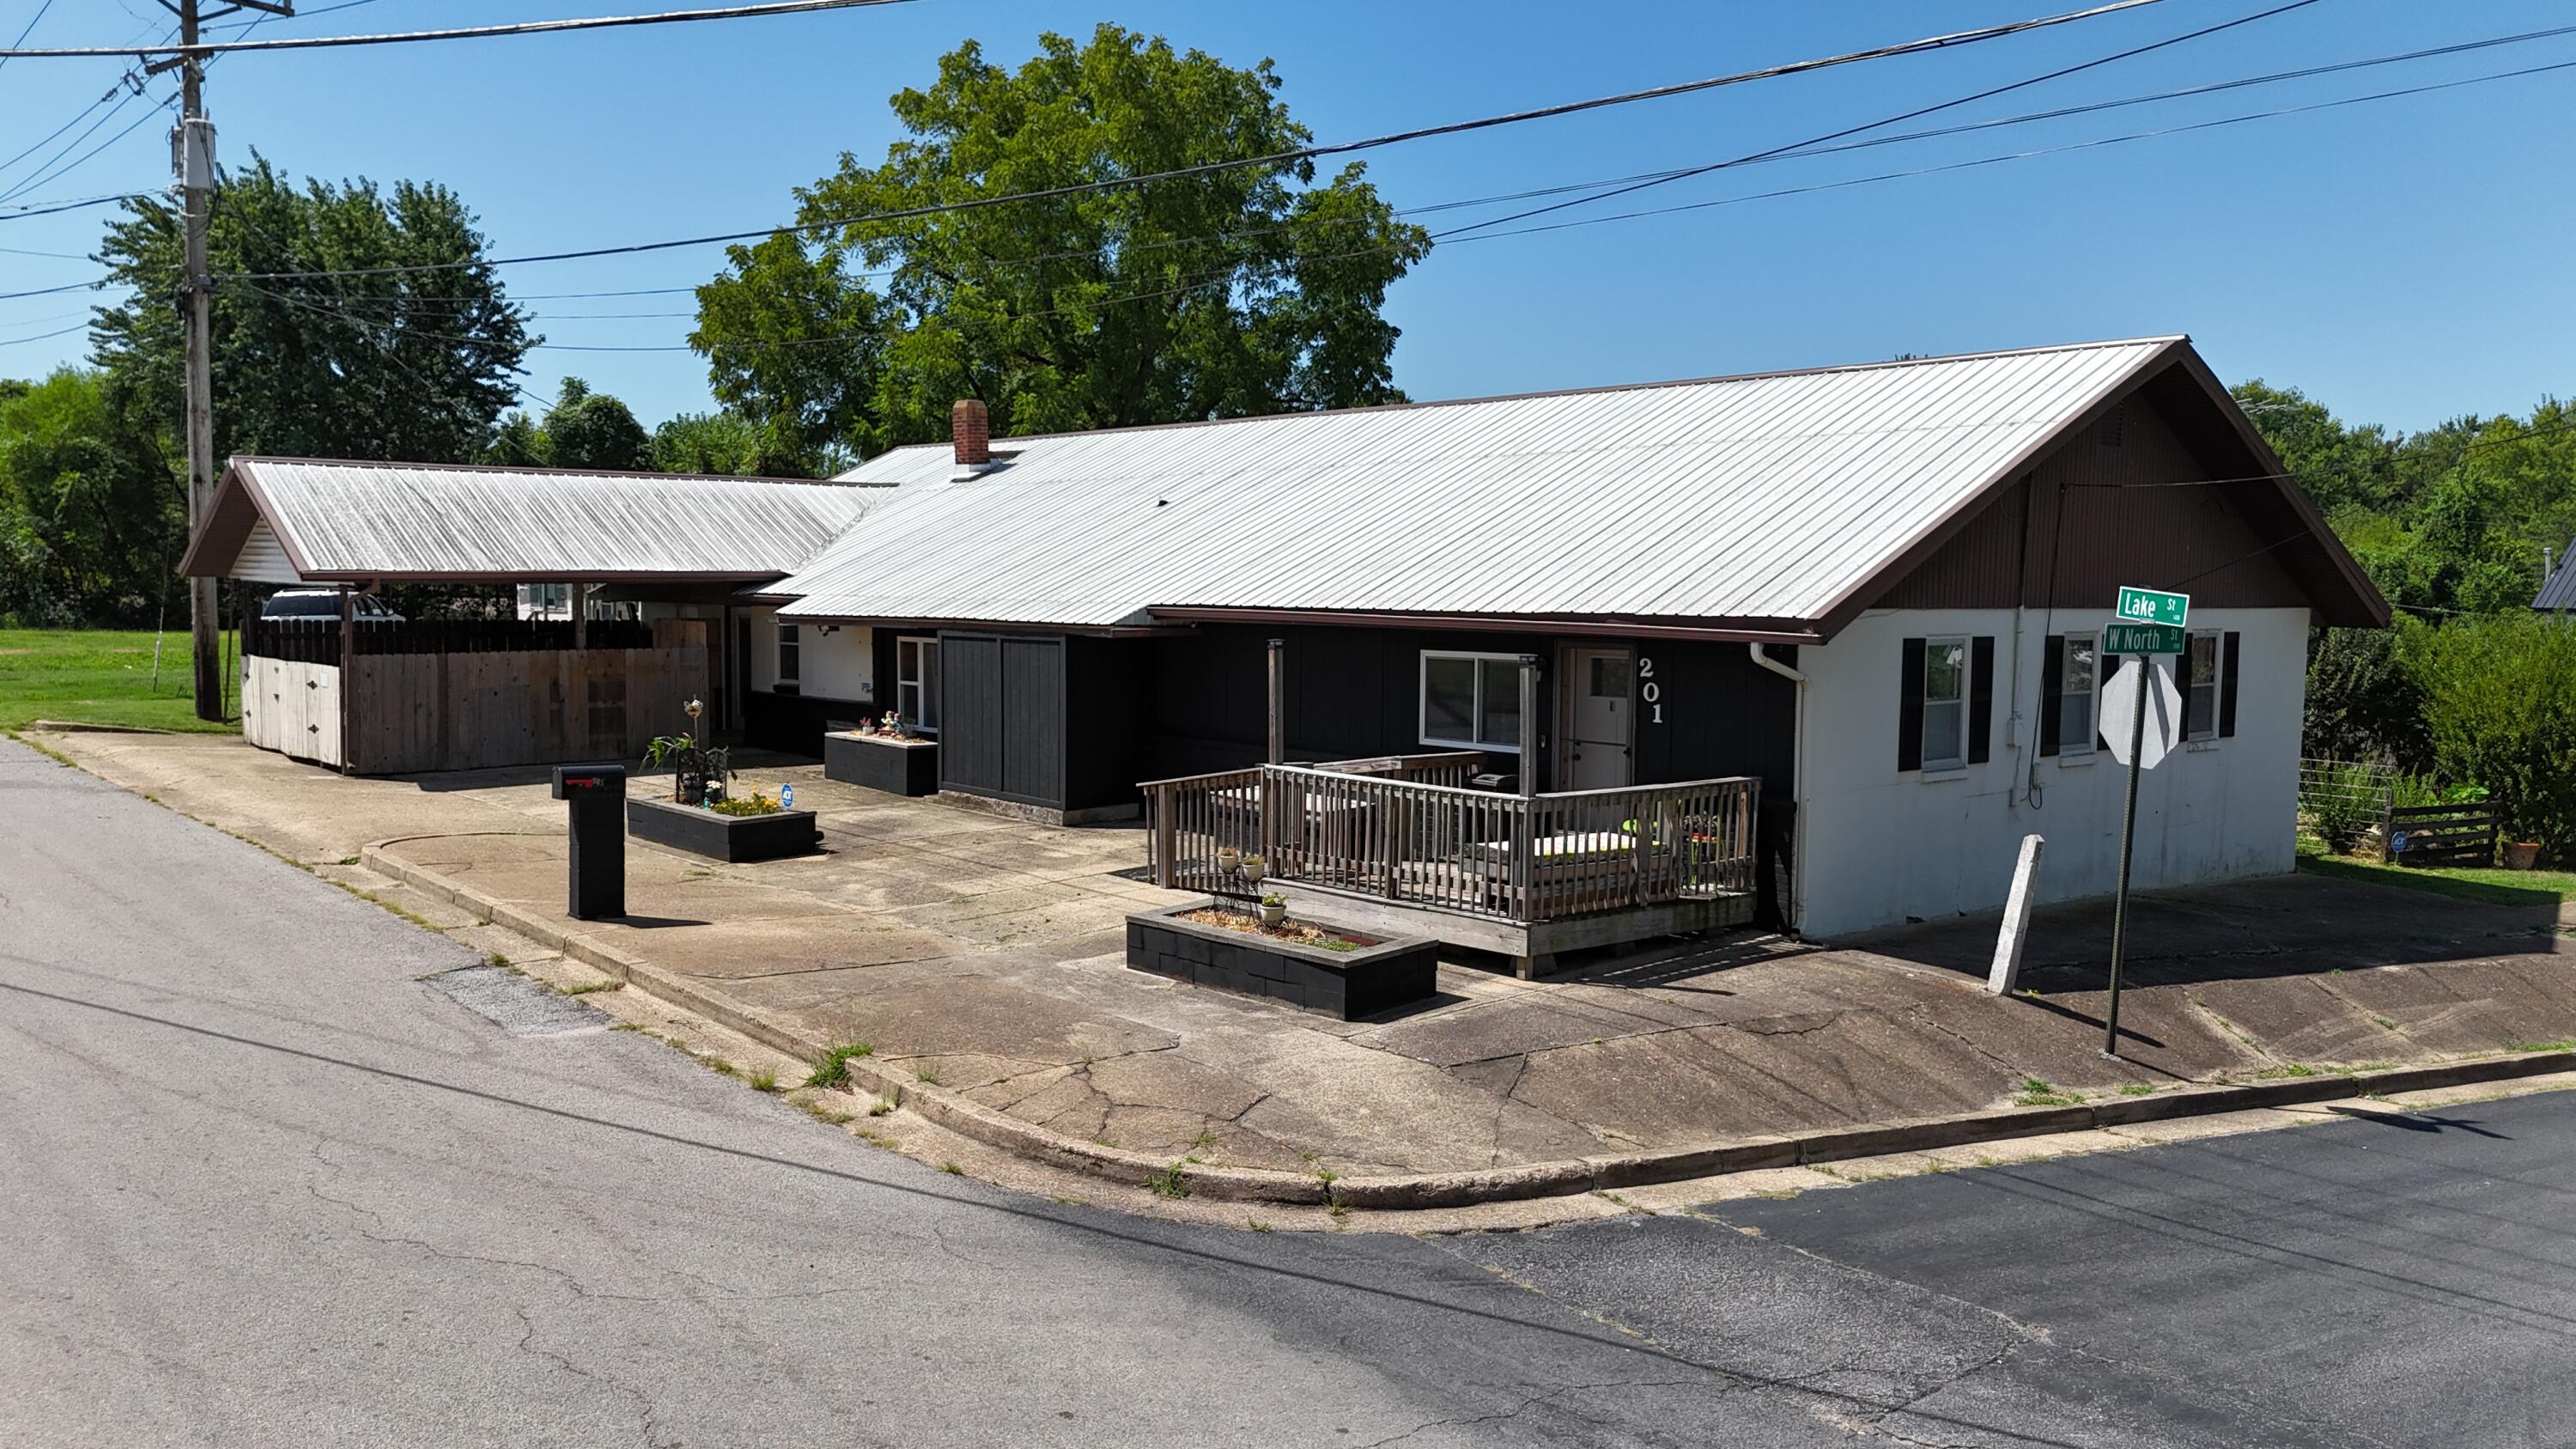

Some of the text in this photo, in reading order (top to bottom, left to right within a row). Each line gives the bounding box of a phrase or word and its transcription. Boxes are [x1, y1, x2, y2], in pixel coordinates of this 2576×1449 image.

[2124, 593, 2177, 618] Lake St
[2109, 628, 2178, 649] W North St
[1639, 658, 1663, 723] 201
